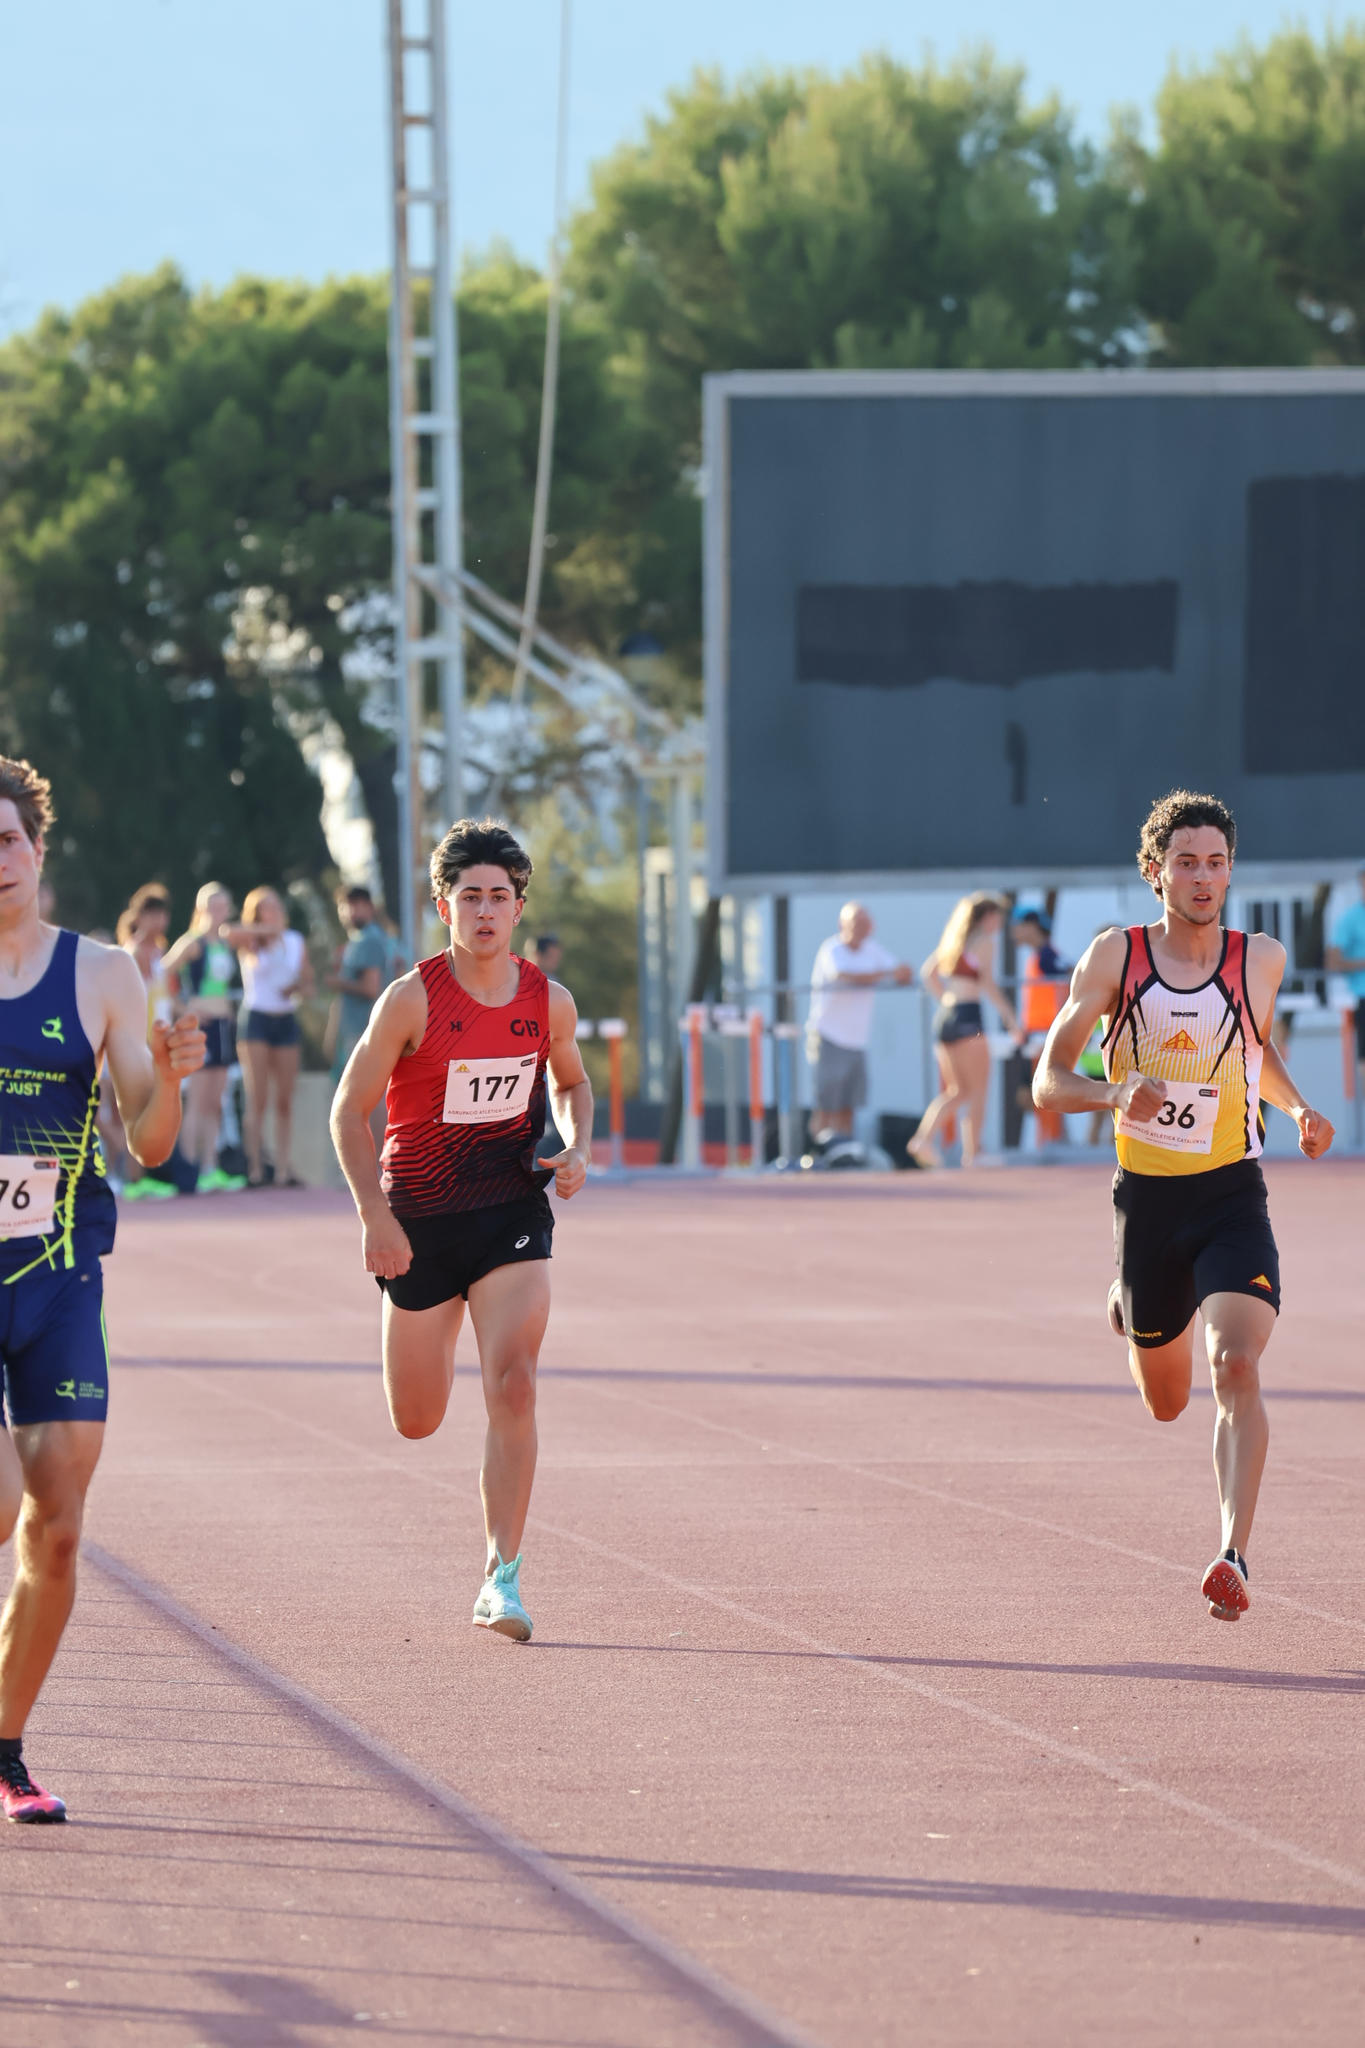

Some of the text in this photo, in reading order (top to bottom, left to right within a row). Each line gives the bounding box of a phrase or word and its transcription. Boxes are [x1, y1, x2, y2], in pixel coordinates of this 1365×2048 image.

[6, 1081, 42, 1096] JUST
[468, 1074, 520, 1103] 177
[1157, 1100, 1196, 1130] 36
